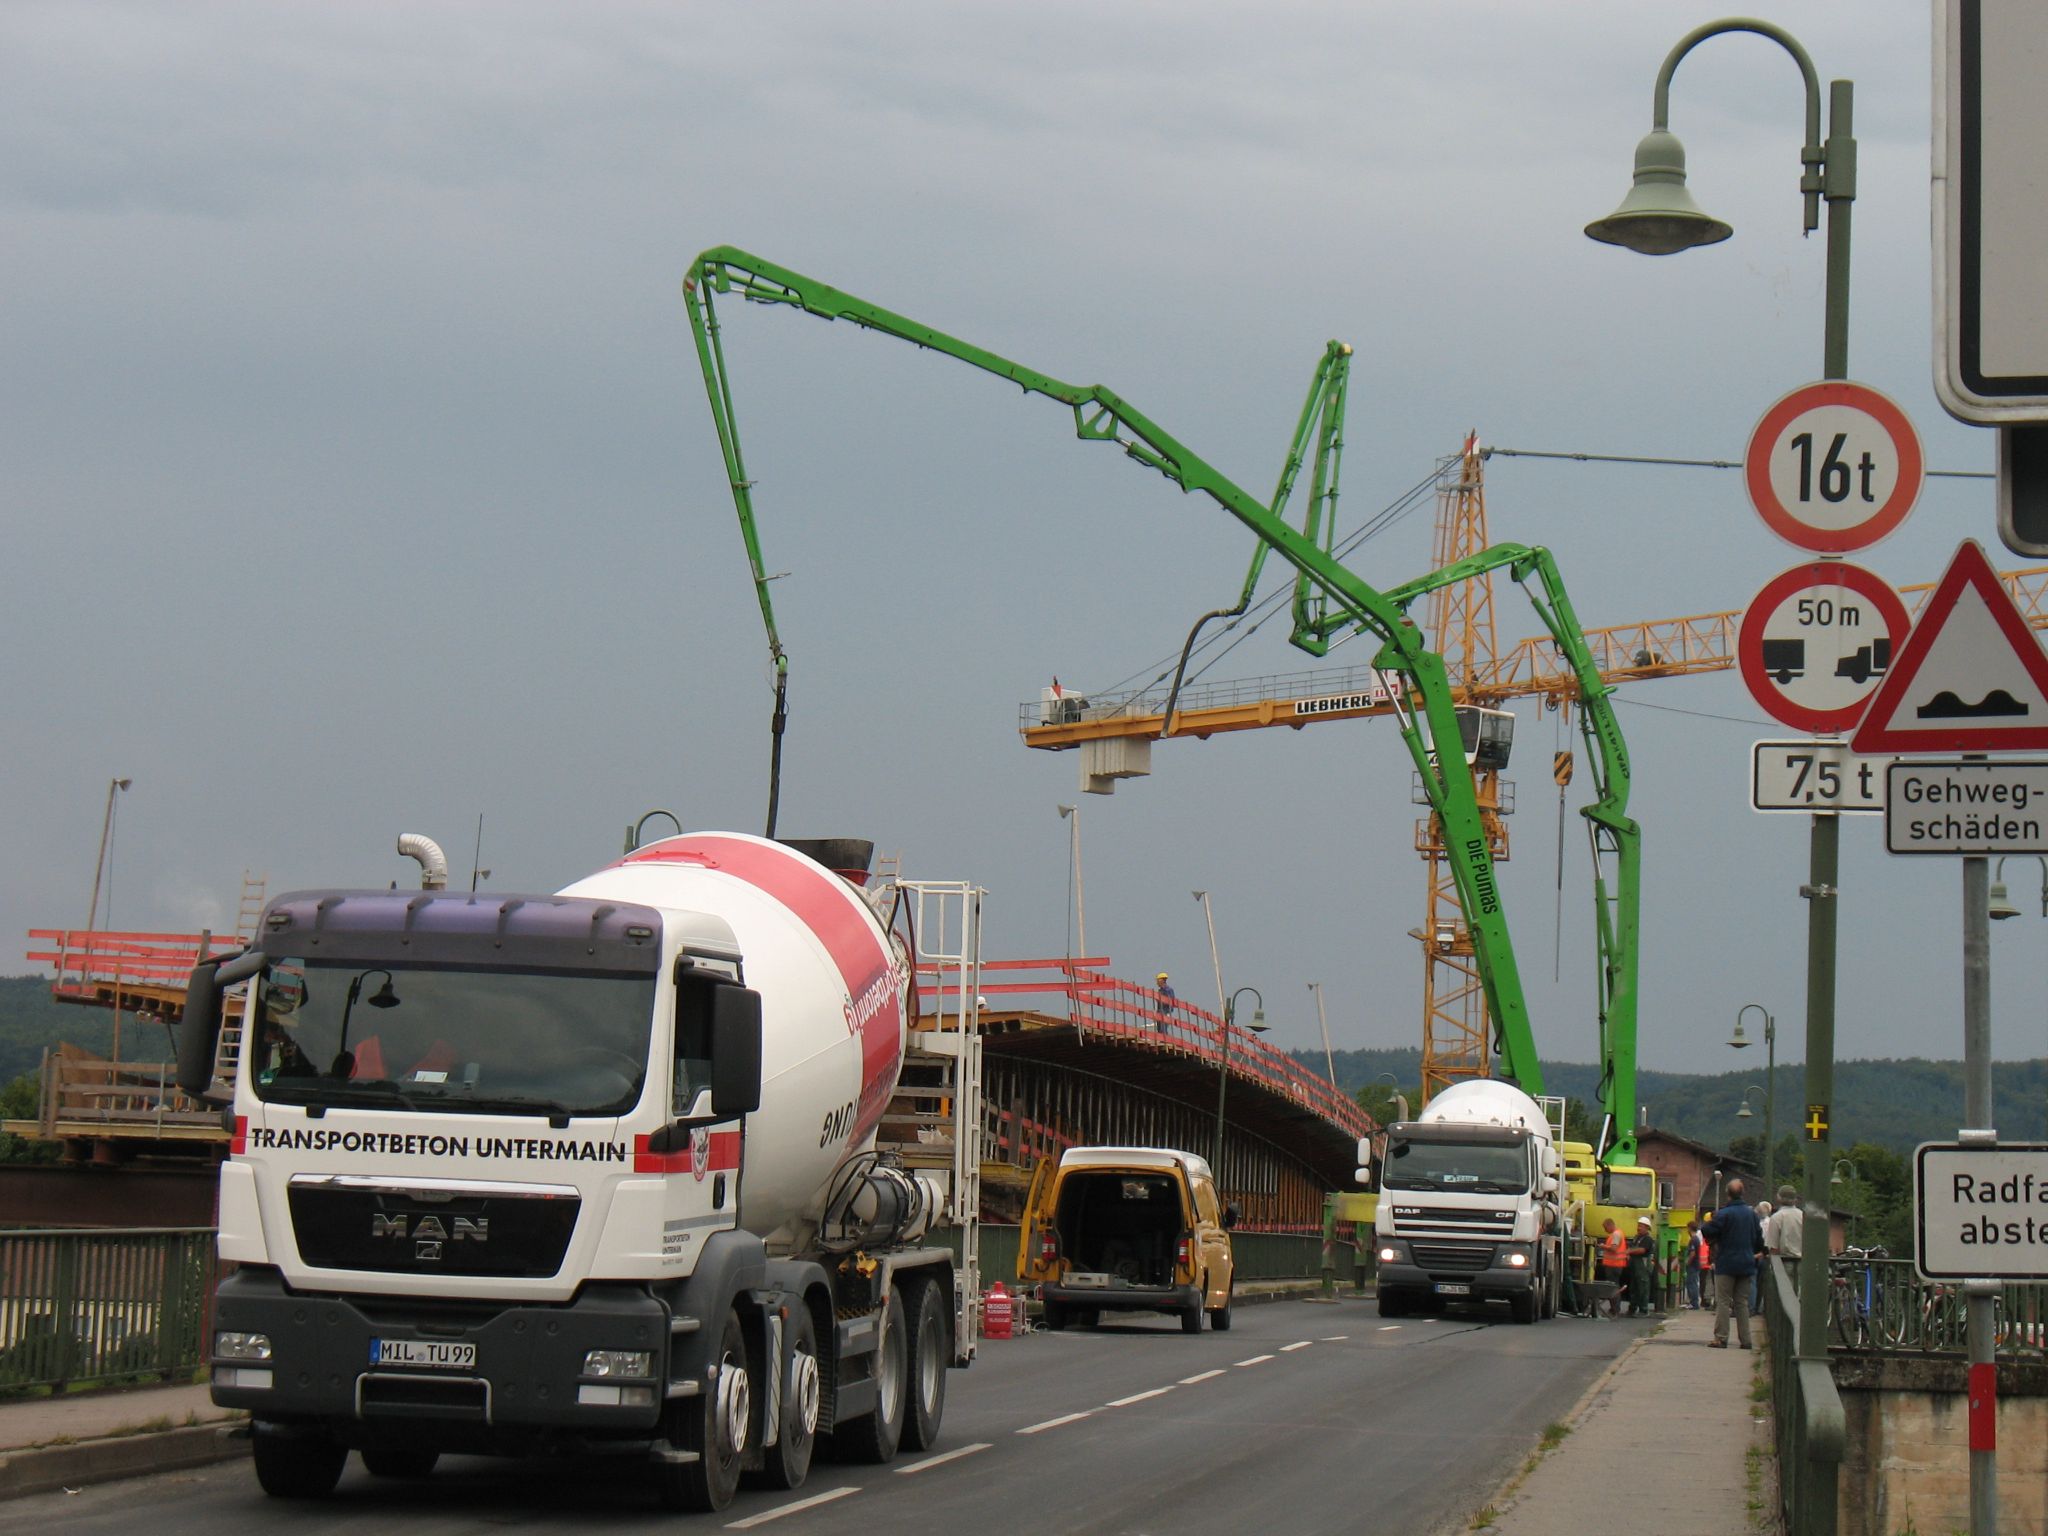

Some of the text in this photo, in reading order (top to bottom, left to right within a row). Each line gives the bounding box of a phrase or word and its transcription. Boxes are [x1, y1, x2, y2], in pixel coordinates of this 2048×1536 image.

[1297, 695, 1373, 714] LIEBHERR
[1786, 755, 1873, 803] 7,5 t
[1904, 777, 2044, 810] Gehweg-
[1910, 814, 2039, 840] schäden
[1466, 839, 1485, 862] DIE
[252, 1128, 626, 1162] TRANSPORTBETON UNTERMAIN
[372, 1213, 488, 1241] MAN
[381, 1343, 414, 1361] MIL
